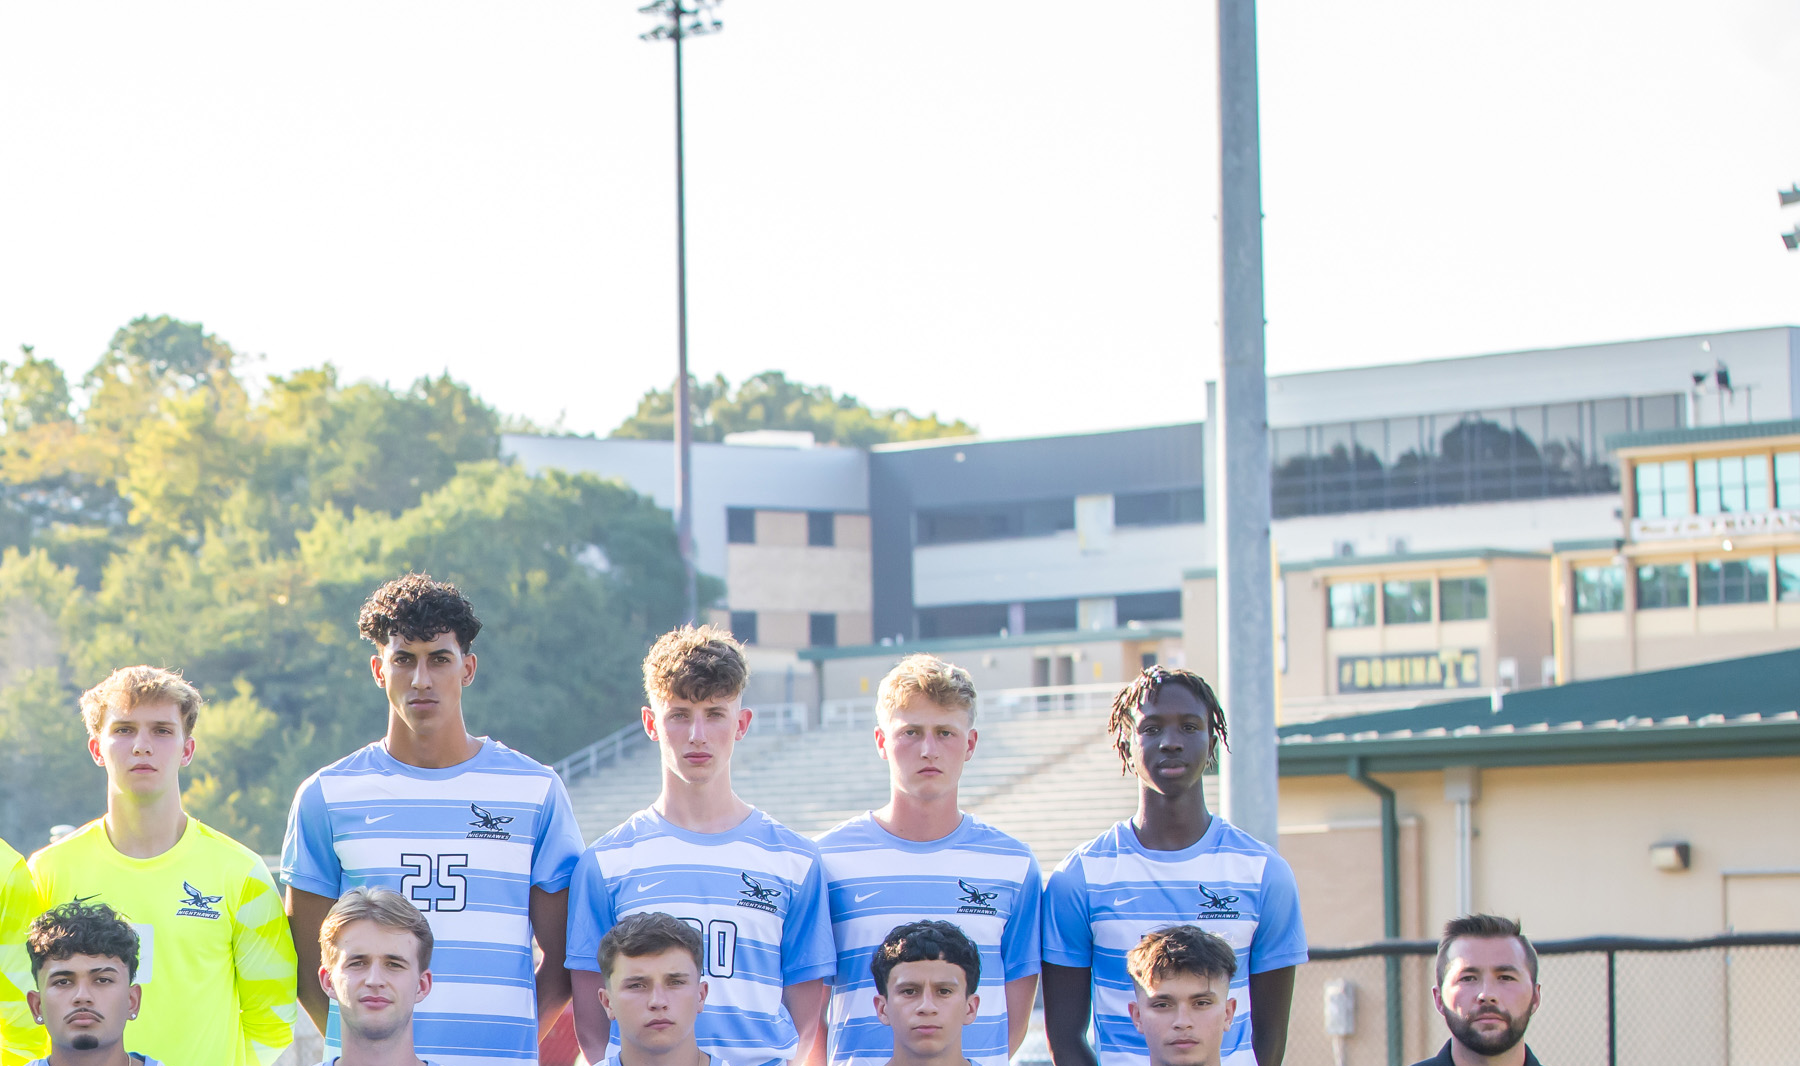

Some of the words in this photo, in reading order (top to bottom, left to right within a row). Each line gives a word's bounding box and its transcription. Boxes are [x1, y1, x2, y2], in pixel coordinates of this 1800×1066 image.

[466, 832, 510, 840] NIGHTHAWKS
[401, 853, 468, 912] 25
[737, 900, 777, 913] NIGHTHAWKS
[957, 907, 997, 915] NIGHTHAWKS
[177, 908, 220, 919] NIGHTHAWKS
[677, 917, 737, 978] 0
